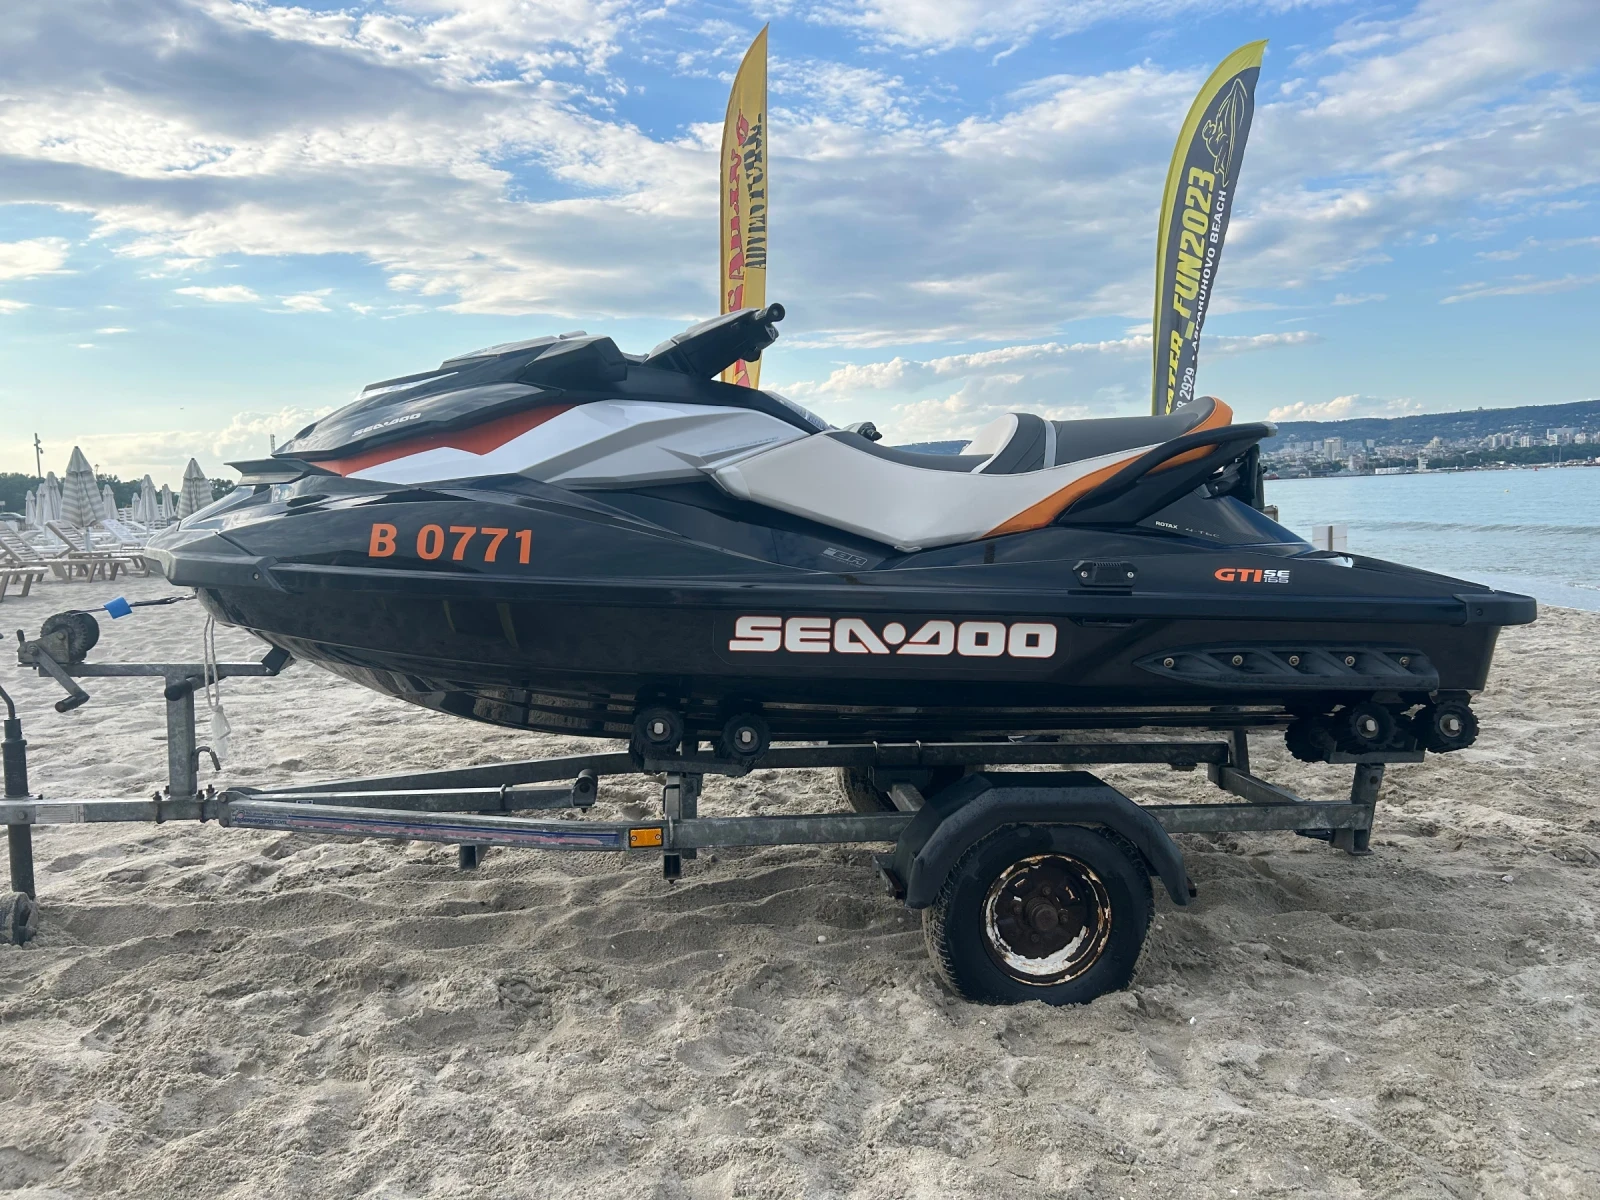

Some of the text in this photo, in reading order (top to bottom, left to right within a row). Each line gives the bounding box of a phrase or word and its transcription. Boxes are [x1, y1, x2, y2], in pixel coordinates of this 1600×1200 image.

[1179, 367, 1195, 400] 2929
[1209, 190, 1227, 244] BEACH
[1155, 520, 1179, 530] ROTAX
[368, 523, 532, 565] B 0771
[1214, 568, 1291, 583] GTI SE
